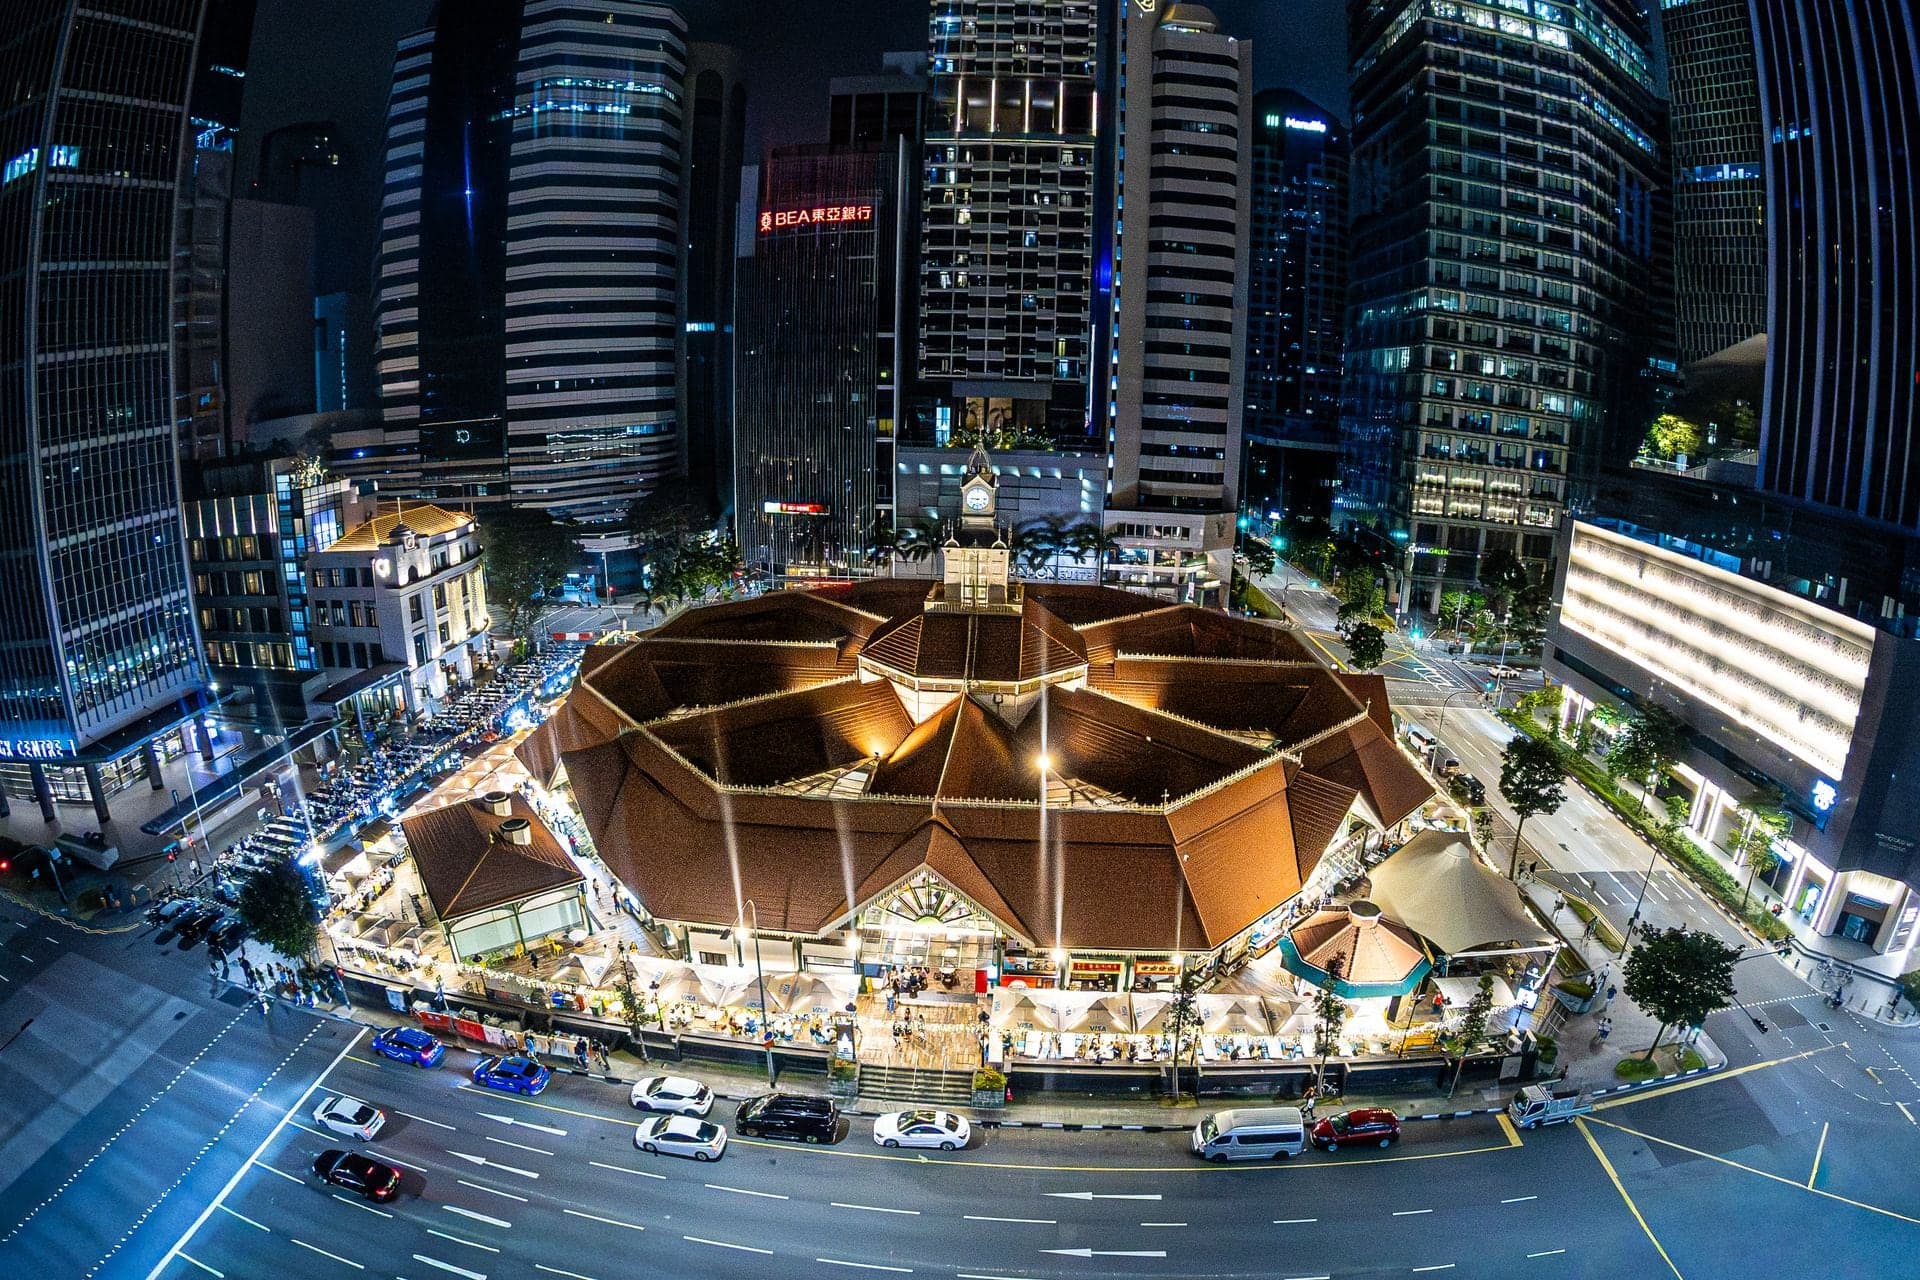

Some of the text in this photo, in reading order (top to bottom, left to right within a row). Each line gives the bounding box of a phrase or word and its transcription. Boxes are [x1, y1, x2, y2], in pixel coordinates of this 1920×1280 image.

[775, 206, 872, 226] BEA 東亞銀行
[17, 739, 63, 758] CENTRE
[67, 739, 77, 757] 1
